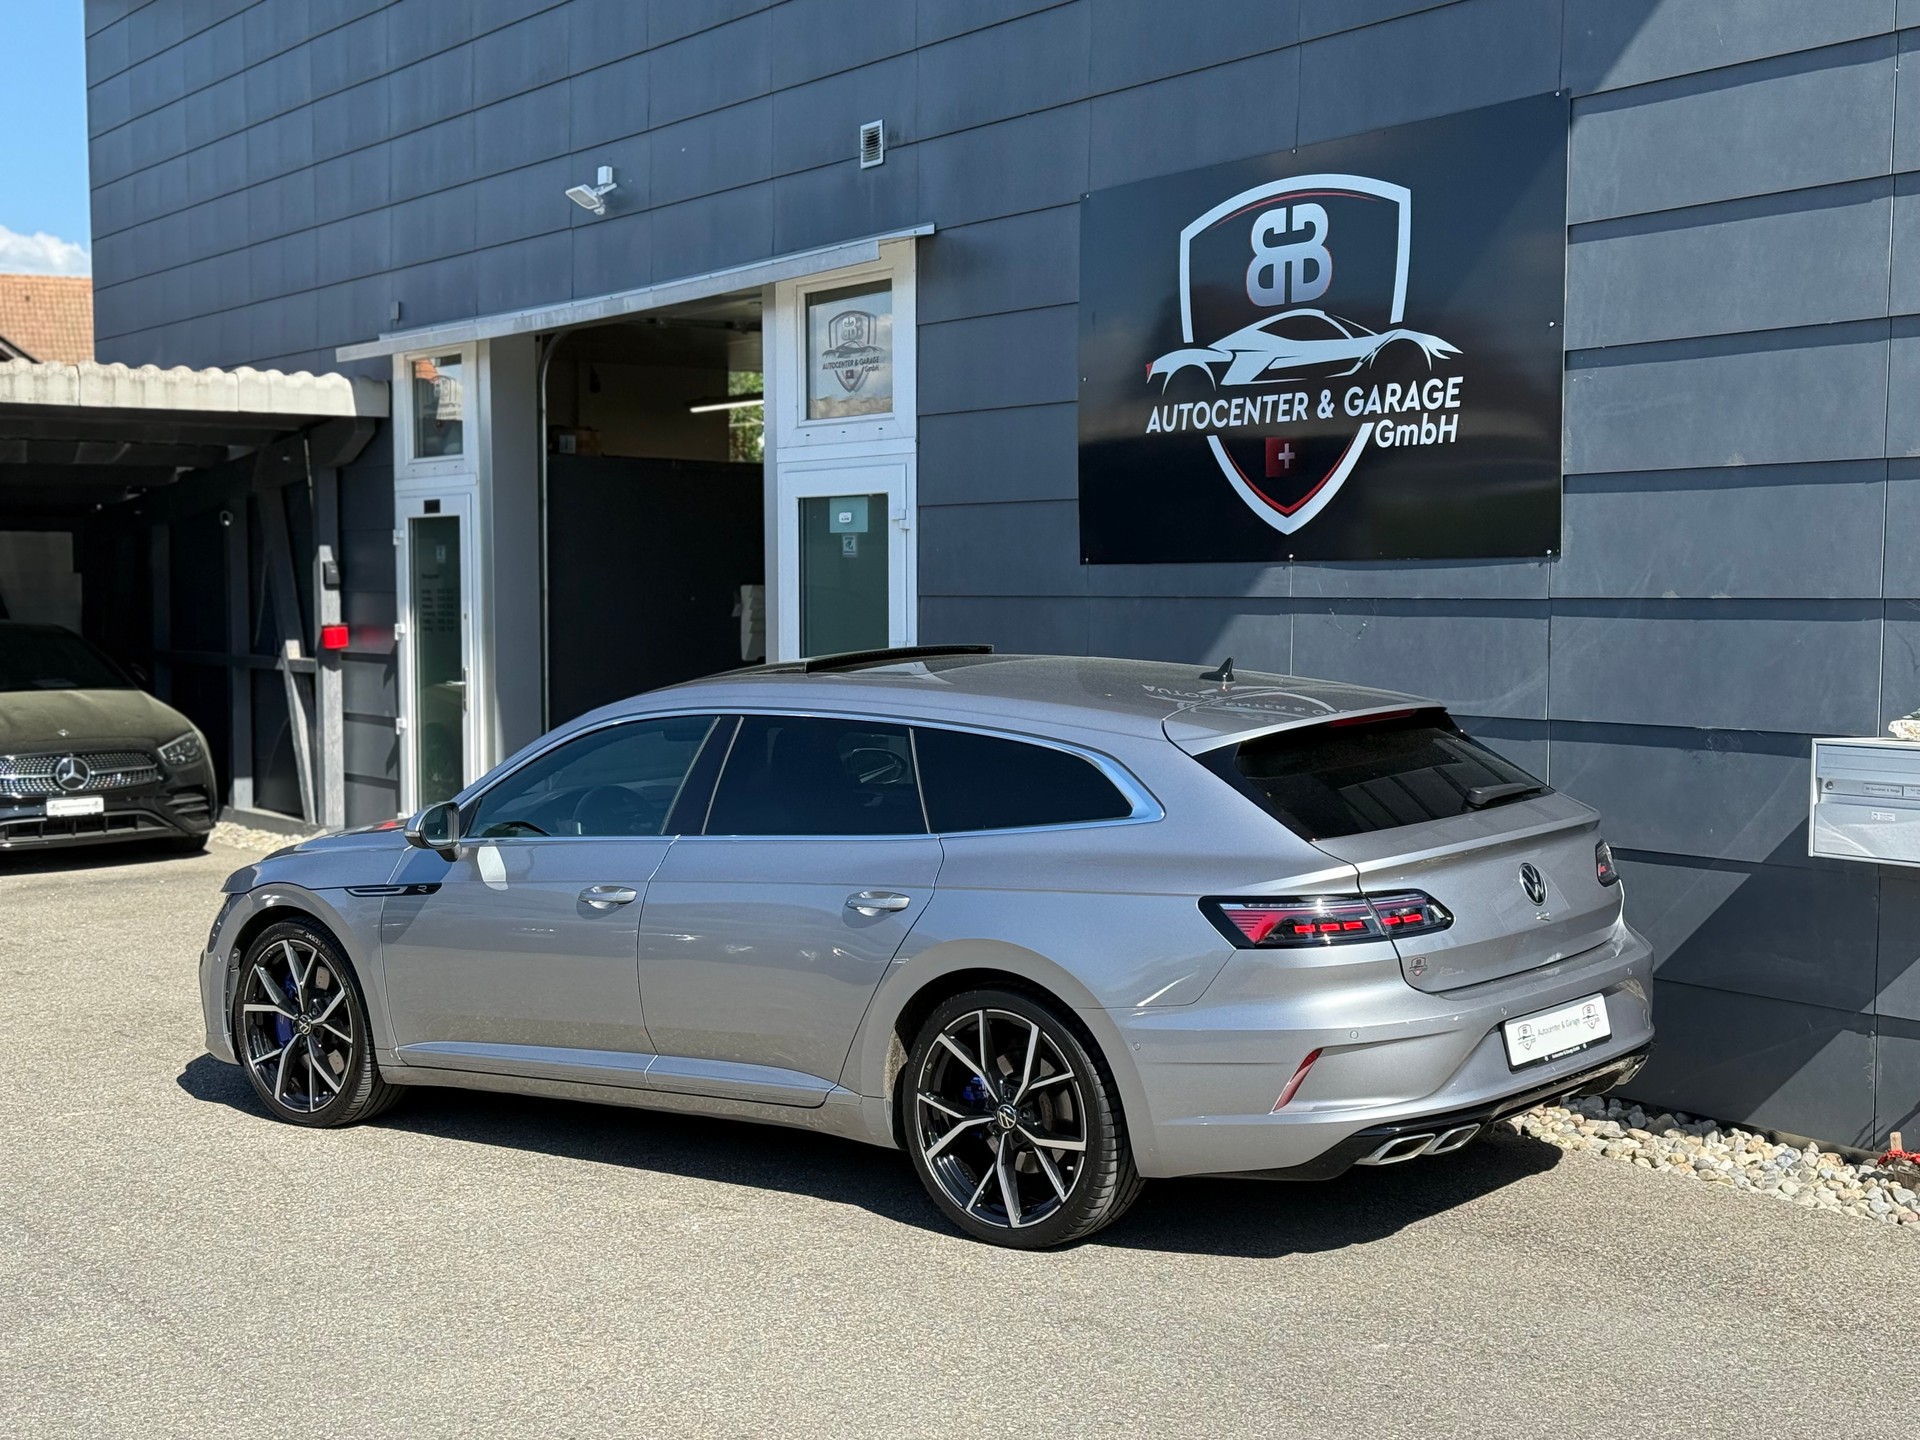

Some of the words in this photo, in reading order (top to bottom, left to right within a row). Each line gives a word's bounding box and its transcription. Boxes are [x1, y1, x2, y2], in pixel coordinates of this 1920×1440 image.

[822, 359, 854, 370] AUTOCENTER
[859, 356, 880, 366] GARAGE
[1146, 391, 1308, 434] AUTOCENTER
[1317, 389, 1335, 419] &
[1344, 376, 1464, 416] GARAGE
[1375, 414, 1459, 448] GmbH
